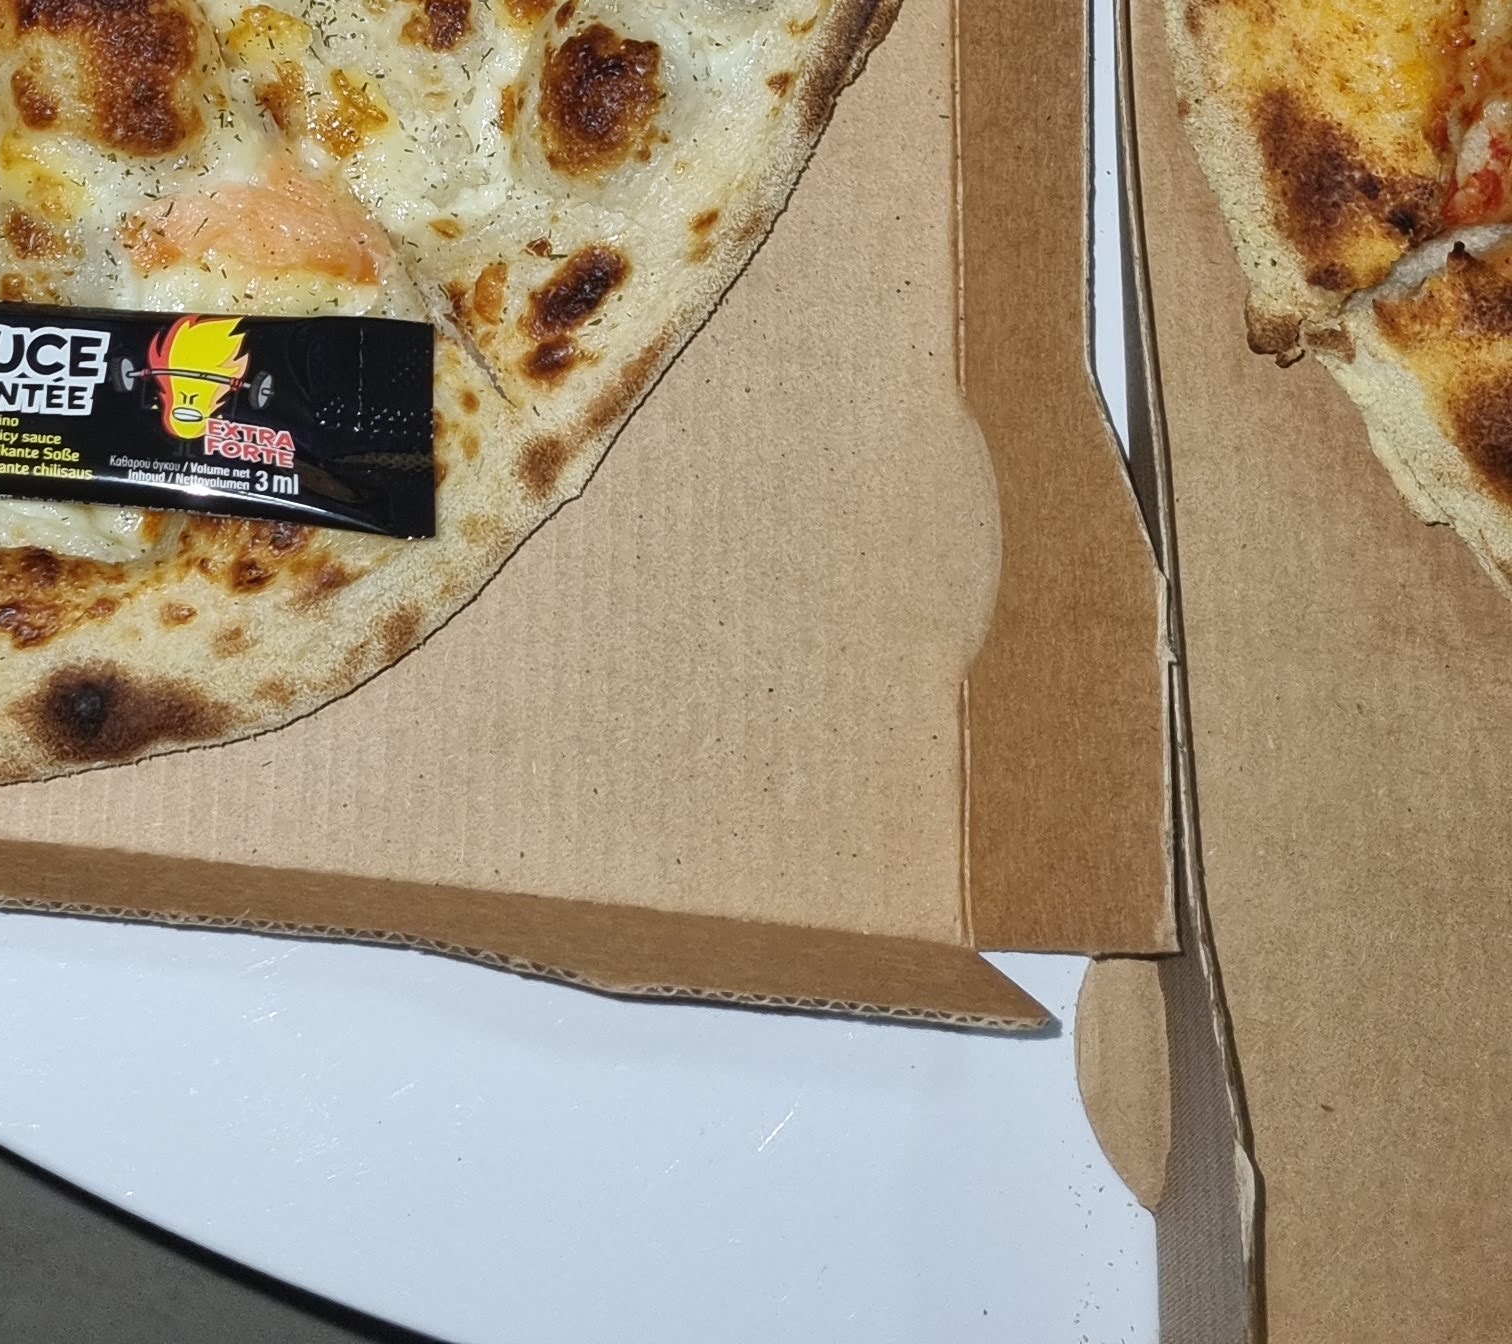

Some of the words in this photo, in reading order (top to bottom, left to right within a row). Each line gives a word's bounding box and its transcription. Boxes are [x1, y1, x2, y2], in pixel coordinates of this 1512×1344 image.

[21, 432, 62, 445] sauce
[206, 418, 295, 451] EXTRA
[42, 447, 80, 462] Soße
[204, 436, 294, 468] FORTE
[32, 462, 94, 480] chilisaus
[127, 468, 166, 483] Inhoud
[174, 473, 250, 490] Nettovolumen
[190, 463, 229, 477] Volume
[232, 466, 250, 479] net
[255, 470, 269, 492] 3
[272, 473, 300, 495] ml
